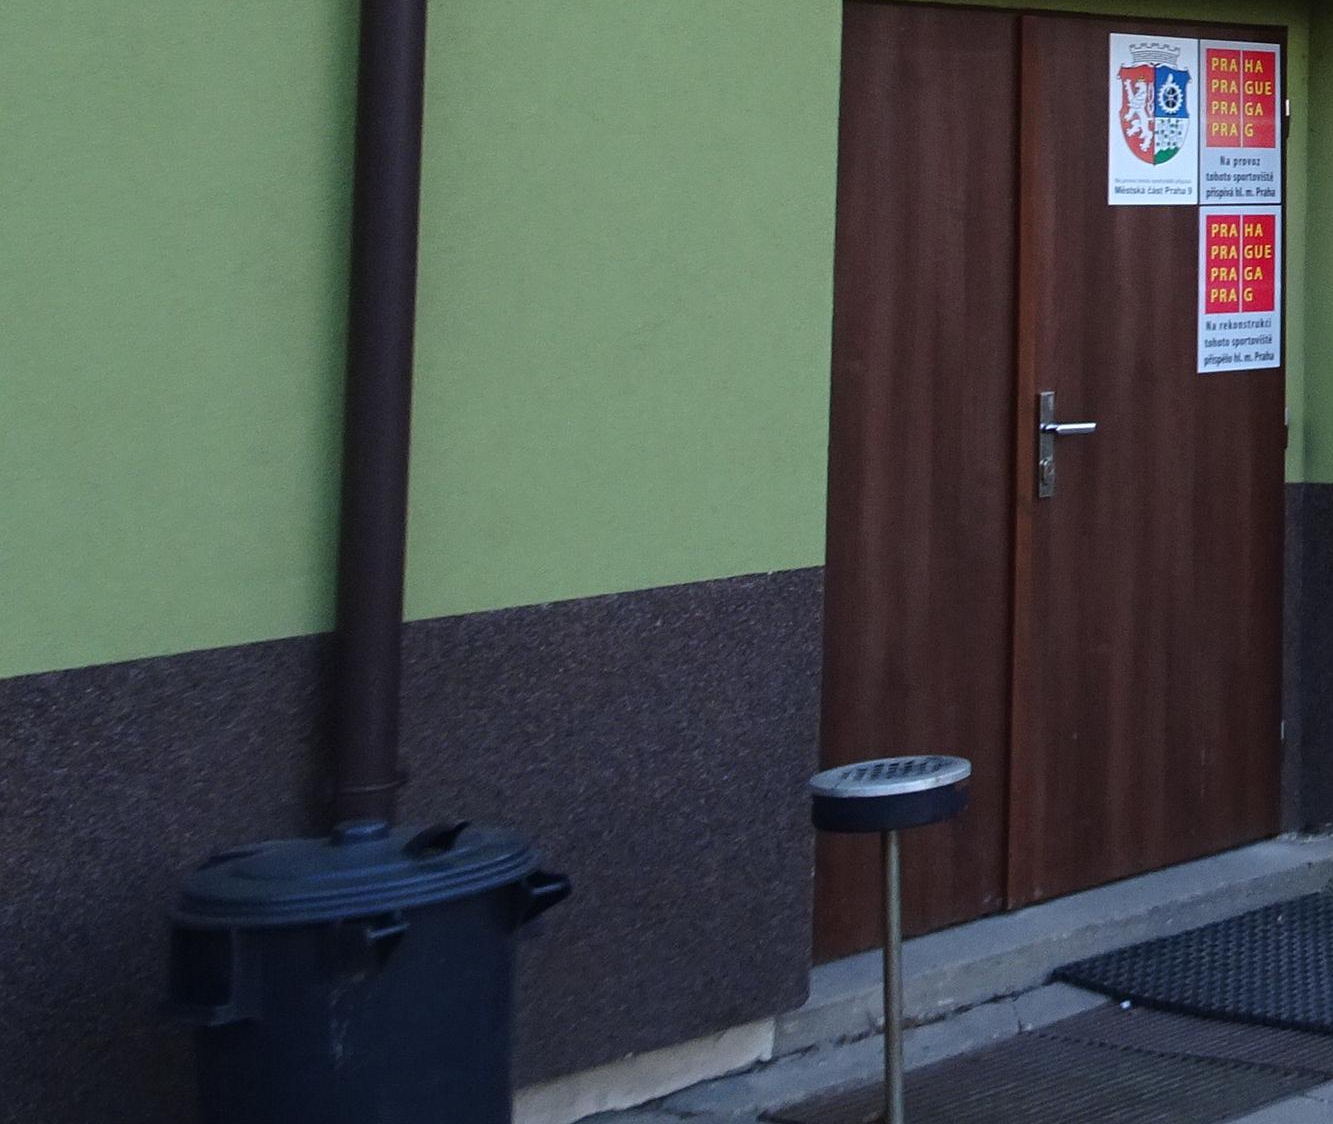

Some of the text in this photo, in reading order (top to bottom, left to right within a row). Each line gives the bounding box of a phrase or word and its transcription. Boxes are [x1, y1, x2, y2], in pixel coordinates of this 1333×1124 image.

[1220, 156, 1261, 168] Na provoz
[1206, 171, 1274, 183] tohoto sportoviště
[1164, 186, 1187, 195] Praha
[1255, 186, 1276, 197] Praha
[1206, 320, 1217, 331] Na
[1204, 333, 1273, 348] tohoto sportoviště
[1254, 351, 1275, 362] Praha
